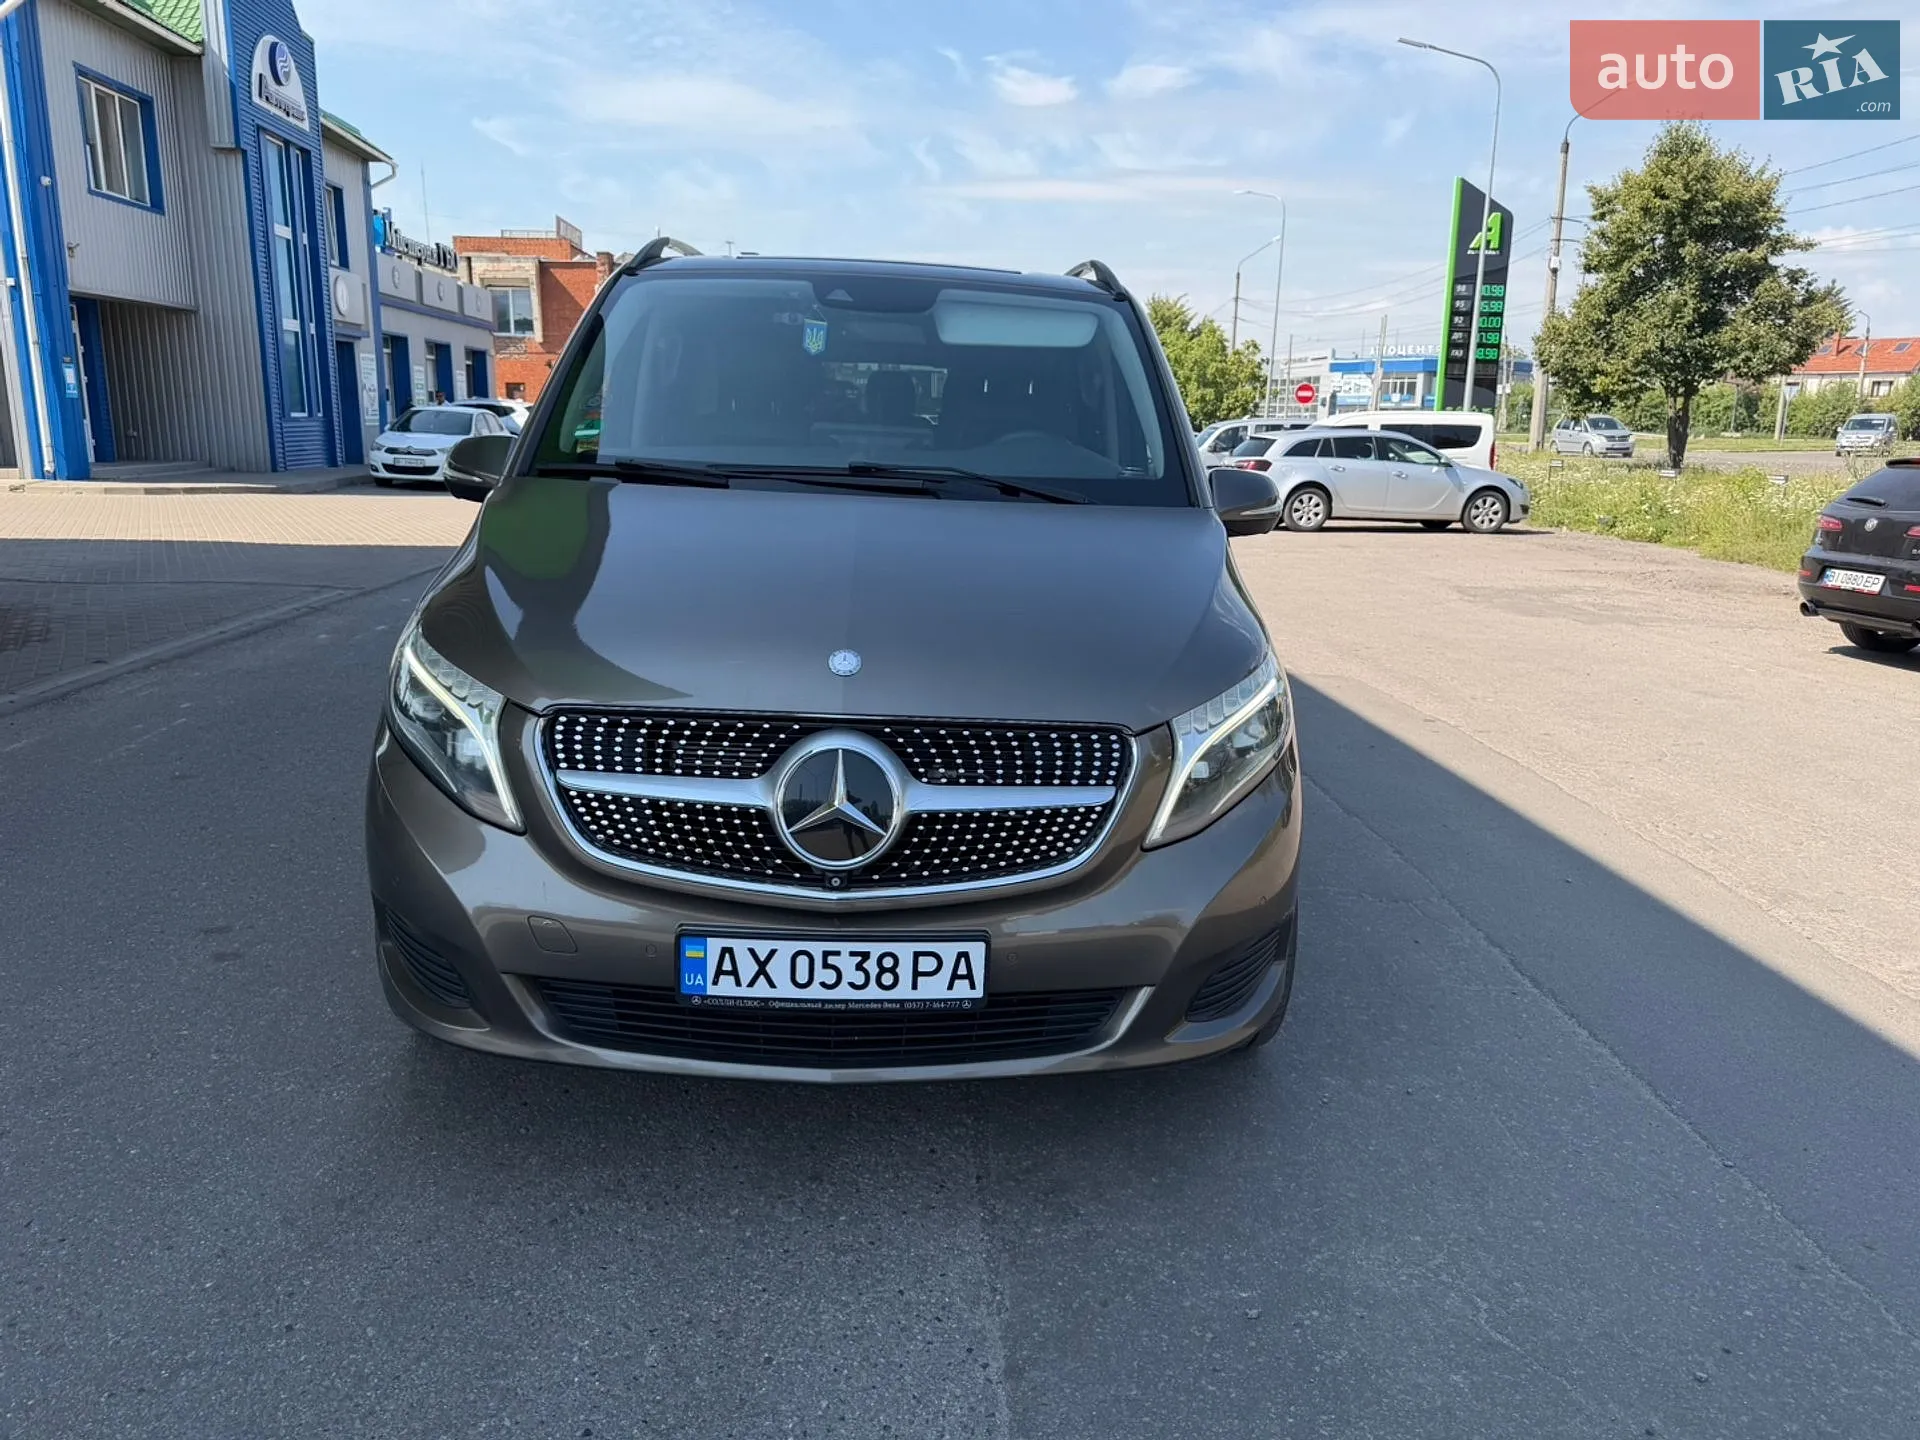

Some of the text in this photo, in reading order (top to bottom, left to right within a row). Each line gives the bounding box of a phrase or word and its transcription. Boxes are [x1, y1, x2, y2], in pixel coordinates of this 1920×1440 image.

[685, 946, 977, 992] UA AX 0538 PA
